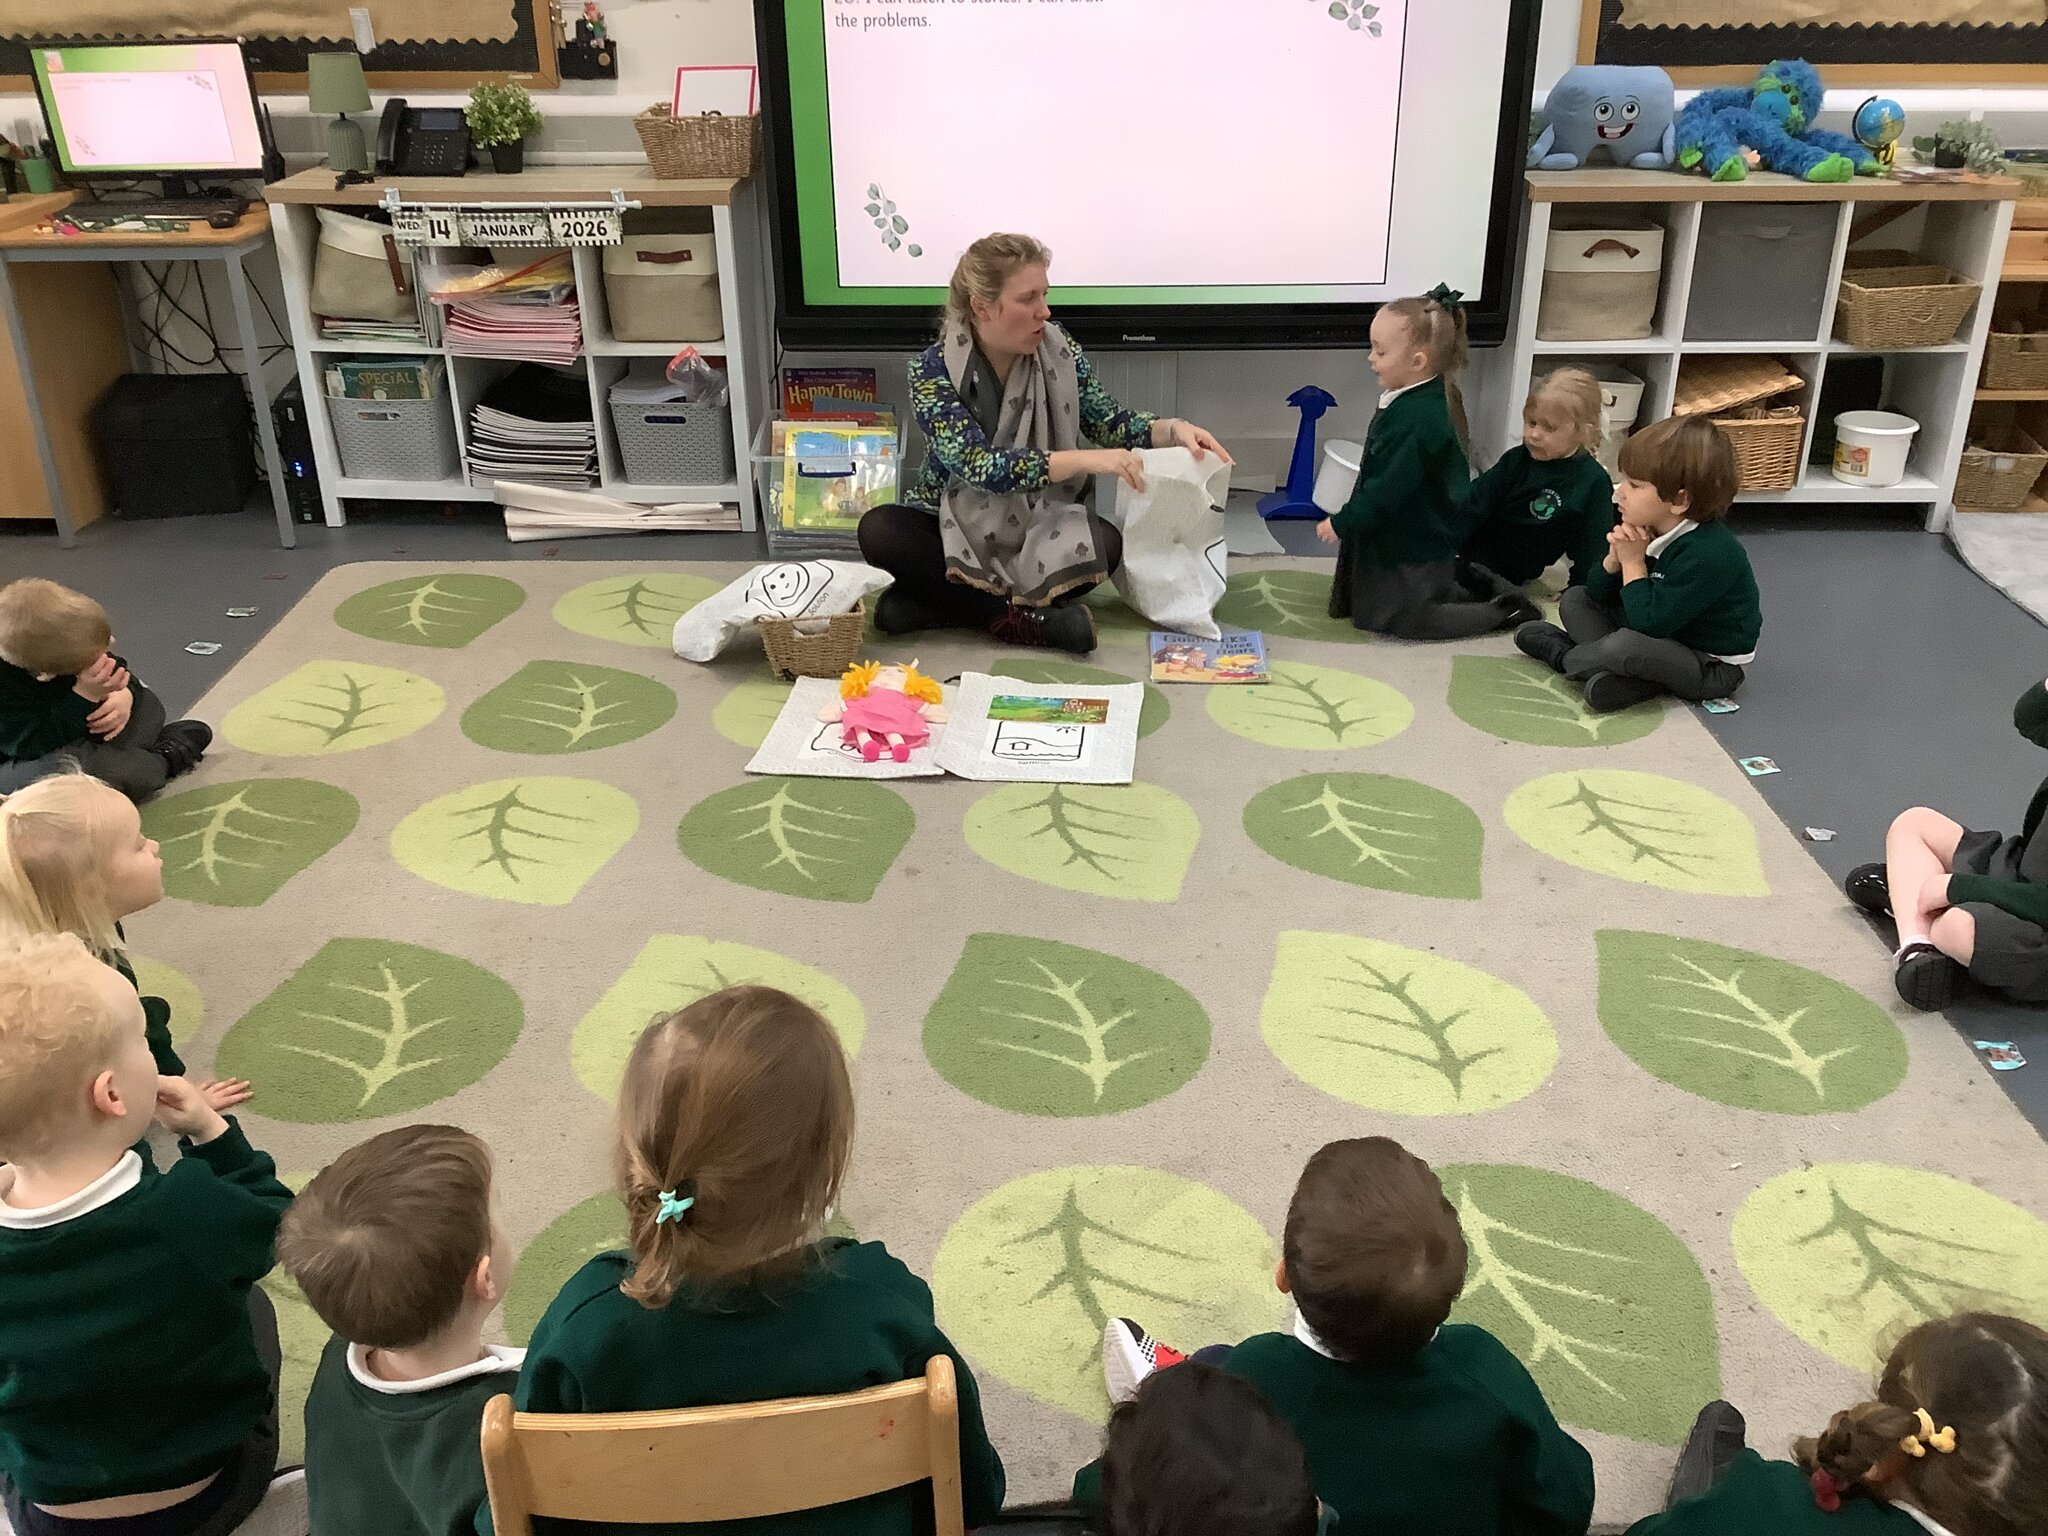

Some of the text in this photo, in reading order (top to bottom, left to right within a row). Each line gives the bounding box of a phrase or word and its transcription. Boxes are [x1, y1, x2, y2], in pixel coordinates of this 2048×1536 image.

[835, 11, 931, 32] the problems.
[429, 219, 450, 239] 14
[472, 224, 536, 237] JANUARY
[561, 221, 608, 238] 2026
[835, 383, 874, 403] Town
